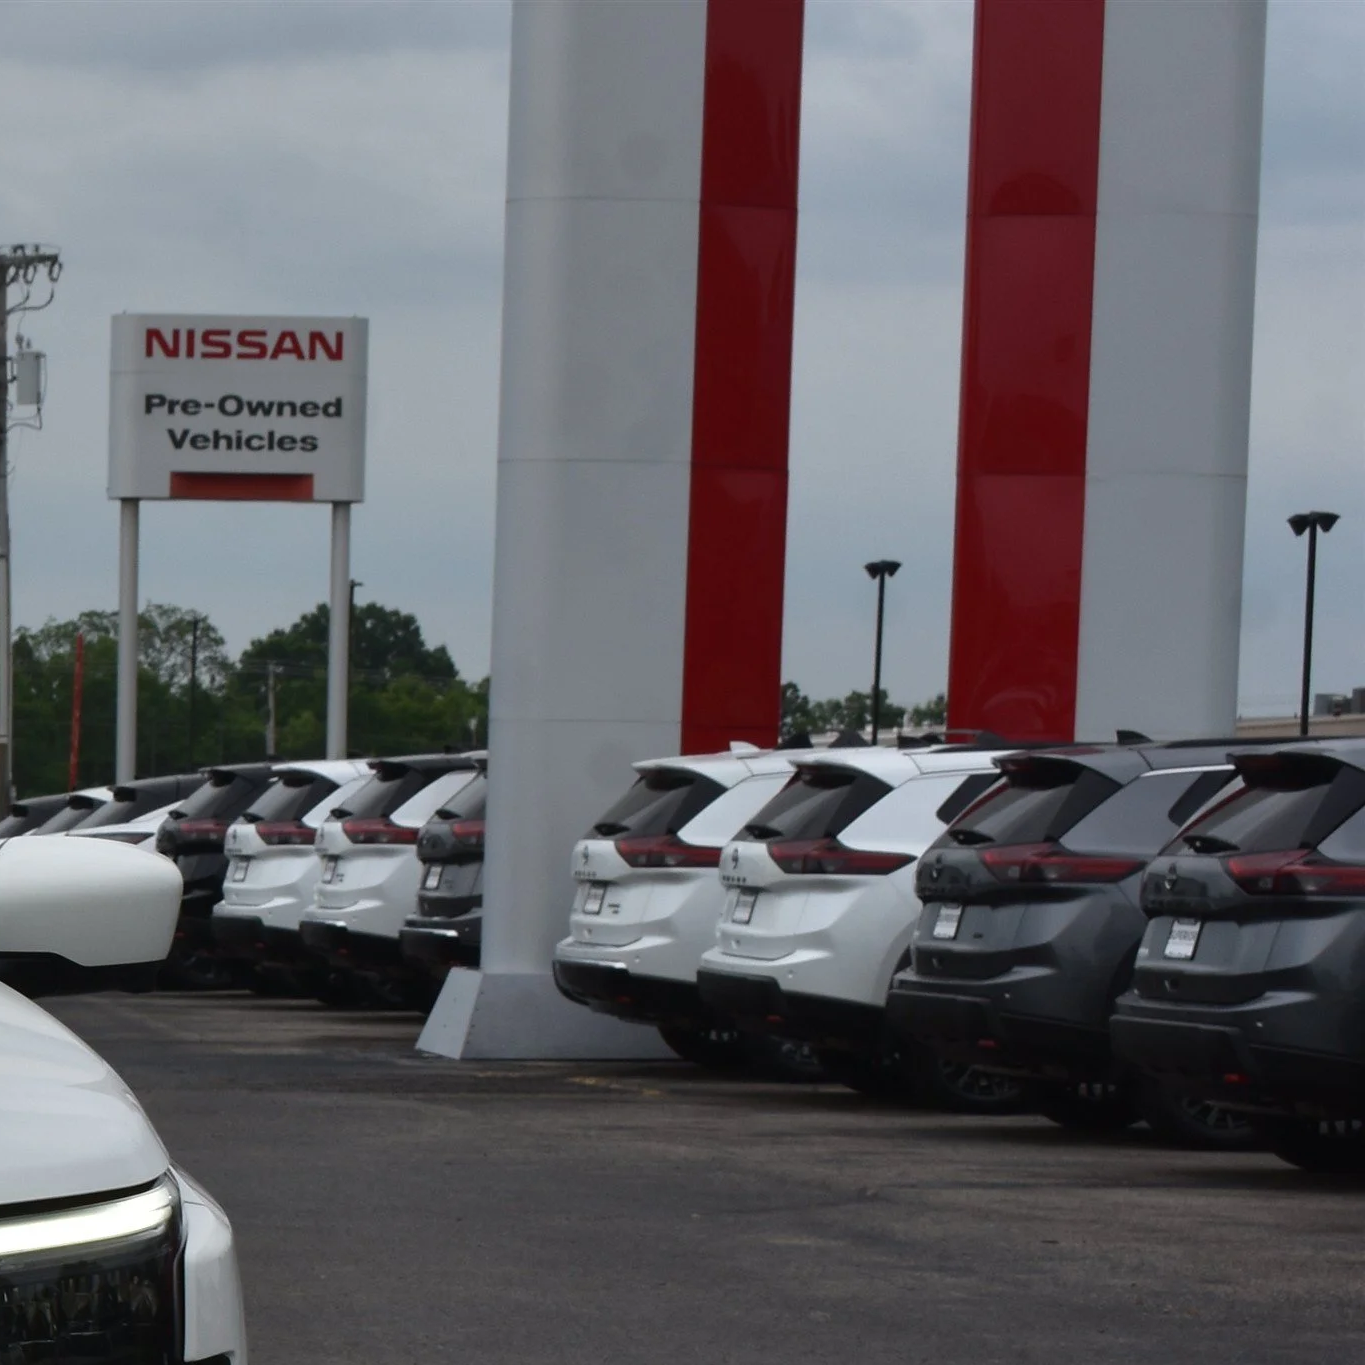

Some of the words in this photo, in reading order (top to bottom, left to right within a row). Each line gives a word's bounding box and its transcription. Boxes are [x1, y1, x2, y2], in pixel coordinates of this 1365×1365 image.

[144, 328, 344, 361] NISSAN
[144, 394, 343, 418] Pre-Owned
[167, 428, 319, 452] Vehicles
